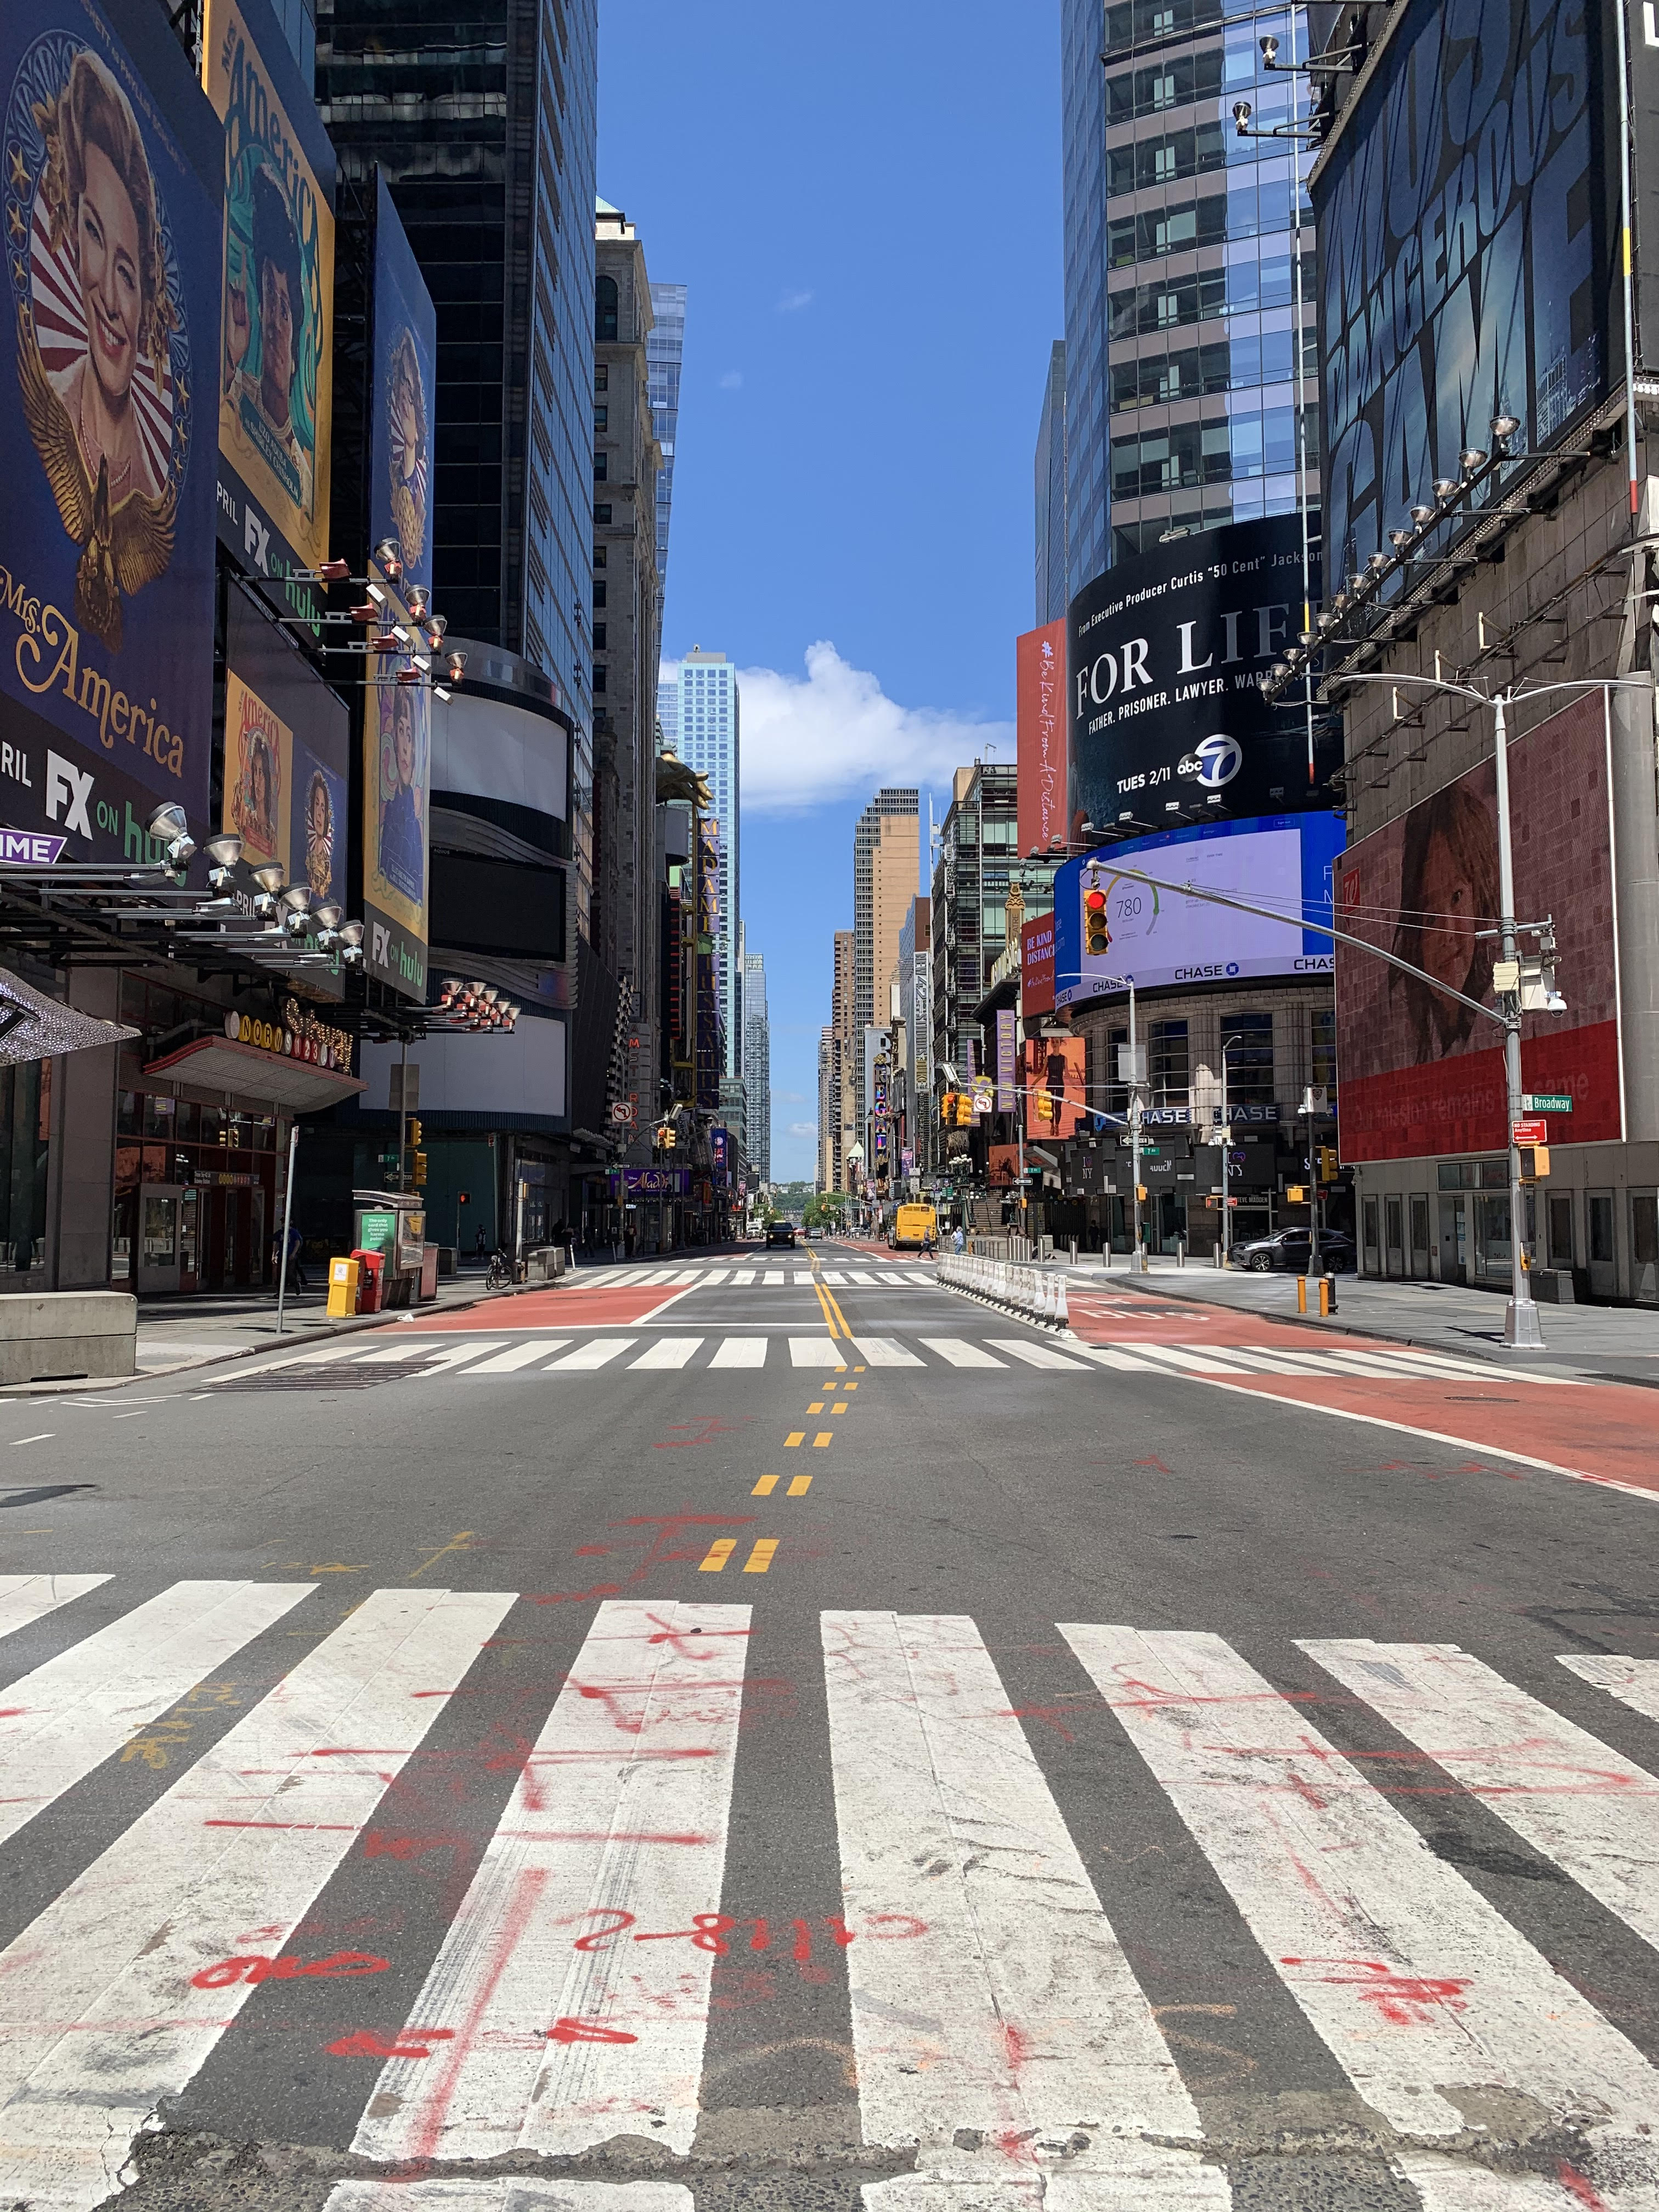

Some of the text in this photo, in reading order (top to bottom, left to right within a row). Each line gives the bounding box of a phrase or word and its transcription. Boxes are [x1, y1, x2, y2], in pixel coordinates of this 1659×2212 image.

[1328, 0, 1589, 447] DANGEROUS
[217, 480, 320, 637] PRIL FX ON hulu
[0, 566, 41, 633] Mrs.
[1079, 620, 1090, 637] From
[1091, 600, 1124, 627] Executive
[1126, 583, 1167, 607] Producer
[1170, 571, 1204, 590] Curtis
[15, 605, 183, 778] America
[1075, 637, 1154, 720] FOR
[1088, 712, 1116, 735] FATHER.
[1118, 692, 1171, 721] PRISONER.
[1175, 678, 1229, 702] LAWYER.
[1116, 766, 1171, 794] TUES 2/11
[1177, 738, 1240, 786] abc 7
[2, 741, 31, 787] RIL
[46, 748, 94, 840] FX
[97, 800, 119, 837] ON
[701, 820, 718, 932] MADAME
[1116, 897, 1142, 919] 780
[372, 921, 423, 988] FX ON hulu
[1027, 930, 1052, 951] BE KIND
[915, 953, 927, 975] NEW
[1175, 965, 1223, 979] CHASE
[916, 975, 927, 1000] 42
[1056, 992, 1067, 1006] CHASE
[1093, 978, 1123, 993] CHASE
[285, 1034, 291, 1051] S
[915, 1014, 927, 1056] STUDIOS
[1000, 1015, 1013, 1073] VICTORY
[627, 1023, 640, 1144] AMSTERDAM
[1001, 1081, 1013, 1109] NEW
[1431, 1085, 1495, 1121] remains
[874, 1068, 887, 1150] REGAL
[1212, 1106, 1277, 1121] CHASE
[1534, 1097, 1570, 1111] Broadway
[1082, 1168, 1093, 1179] NY
[1075, 1308, 1211, 1321] BUS
